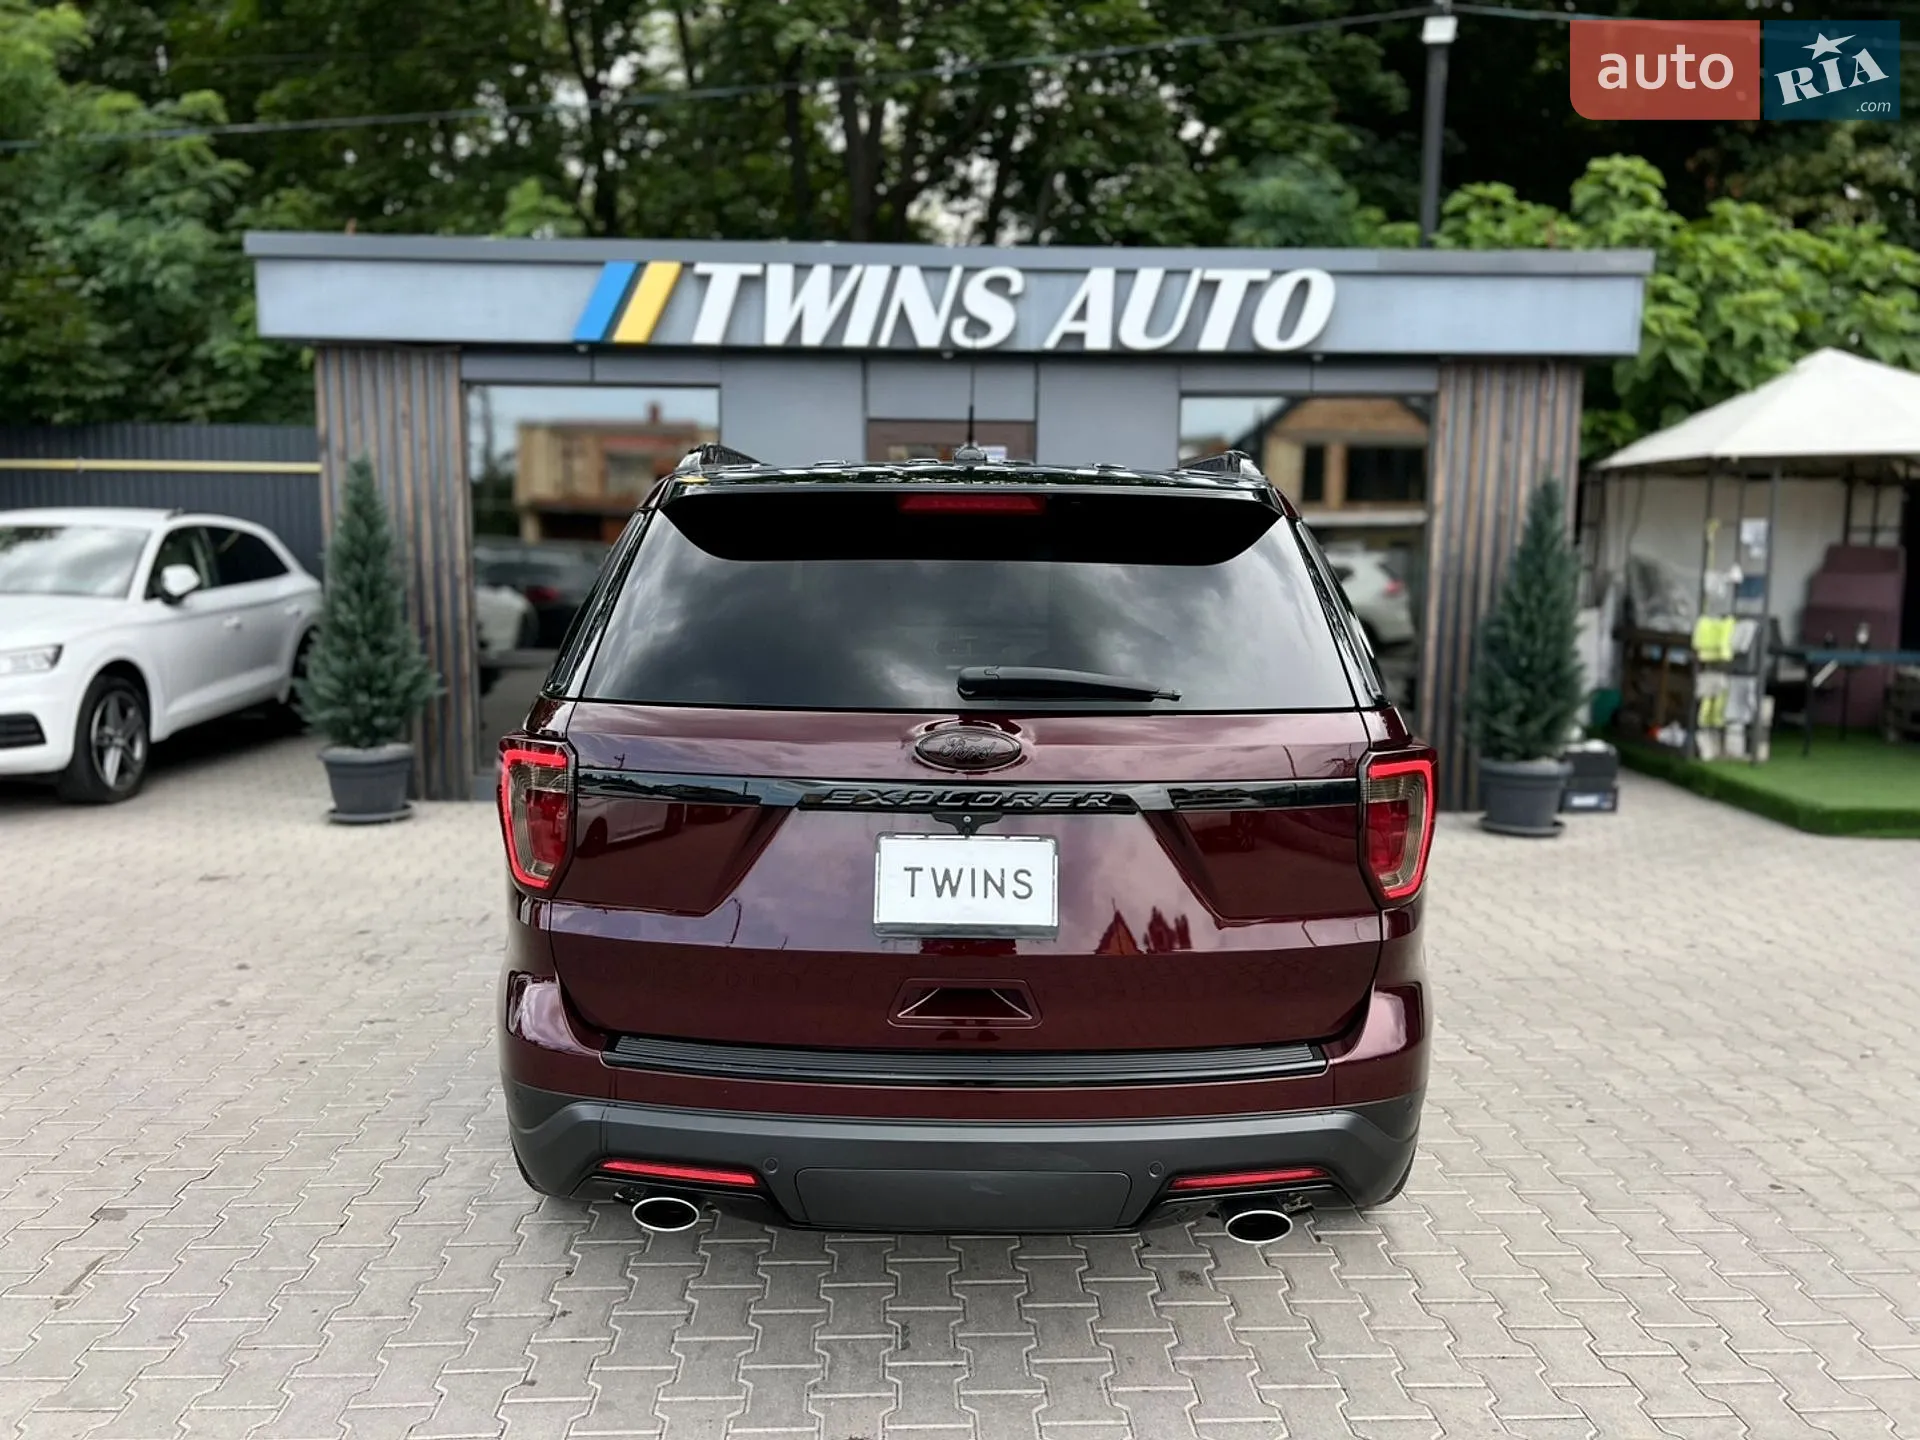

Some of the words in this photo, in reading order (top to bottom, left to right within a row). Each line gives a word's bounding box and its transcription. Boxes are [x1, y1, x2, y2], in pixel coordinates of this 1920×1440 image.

[691, 261, 1025, 349] TWINS
[1044, 267, 1337, 352] AUTO
[939, 735, 997, 760] Ford
[821, 788, 1113, 808] EXPLORER
[903, 866, 1034, 901] TWINS
